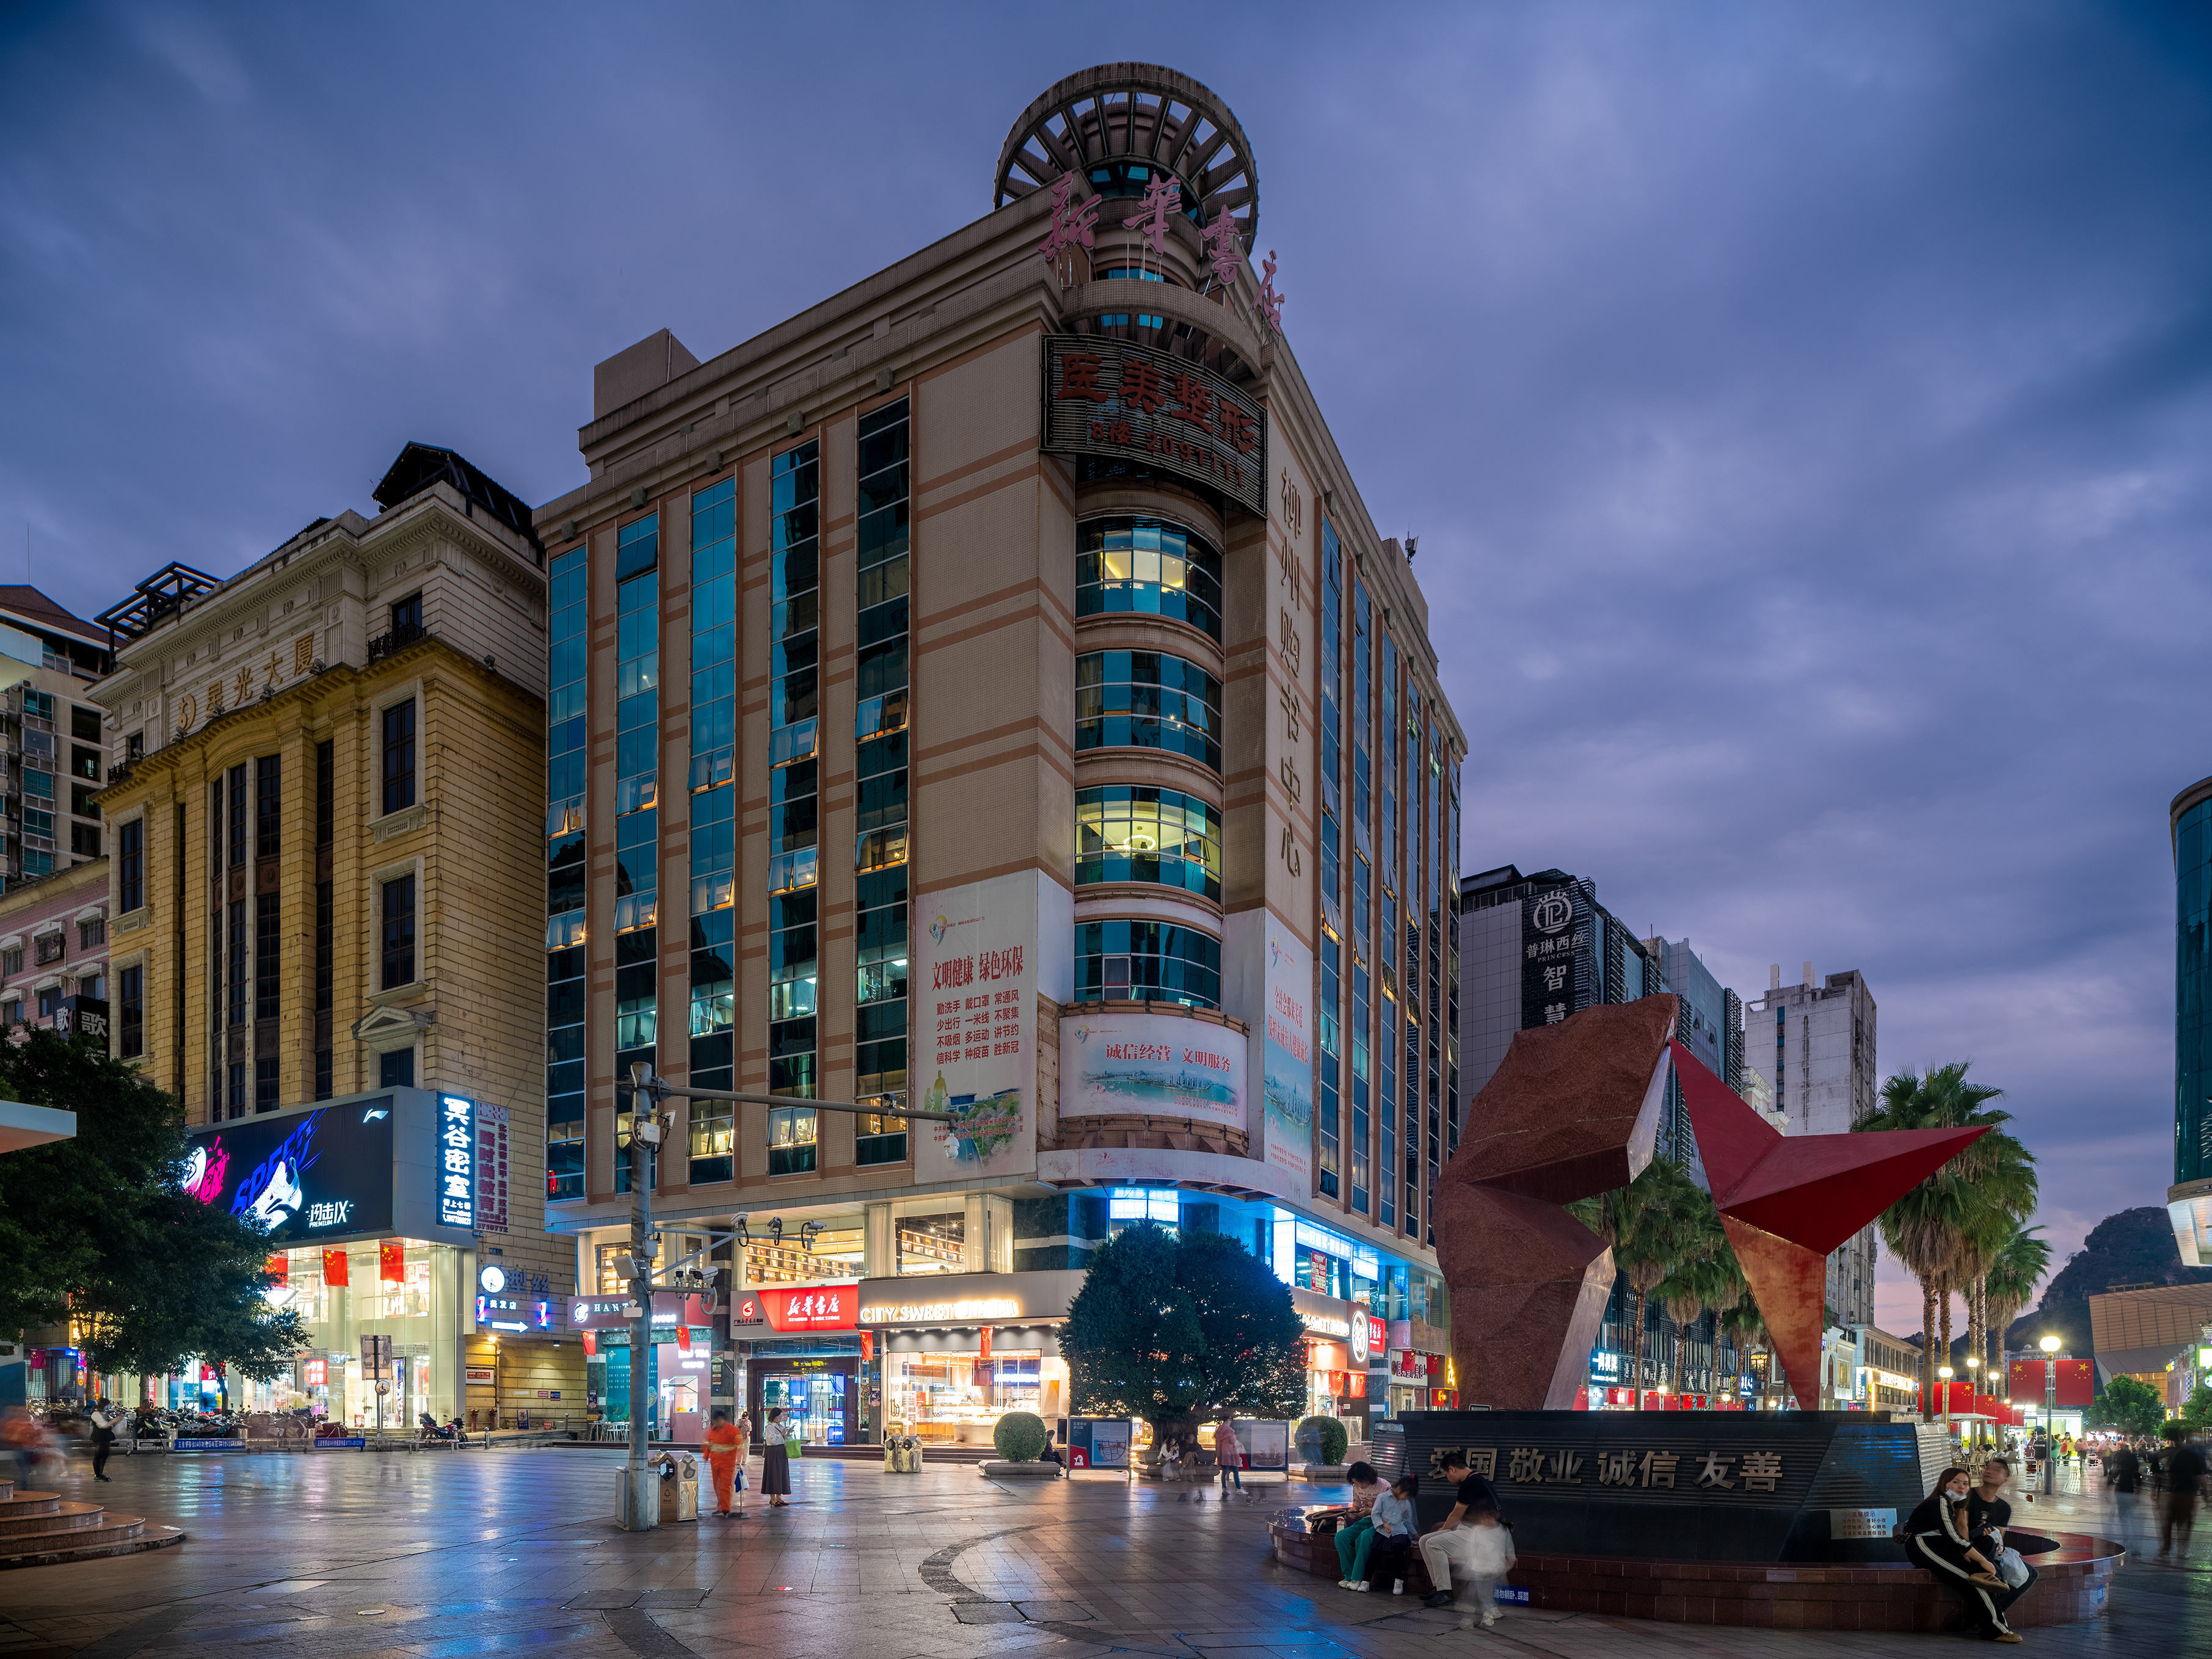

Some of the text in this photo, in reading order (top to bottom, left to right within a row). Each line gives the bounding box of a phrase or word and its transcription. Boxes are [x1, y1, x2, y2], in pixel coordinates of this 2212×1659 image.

[1057, 354, 1256, 453] 医美整形
[1091, 419, 1243, 488] 8楼 2091111
[205, 631, 315, 719] 星光大厦
[1281, 466, 1301, 878] 柳州购书中心
[1526, 932, 1585, 959] 普琳西丝
[1538, 950, 1575, 963] PRINCESS
[931, 945, 1024, 992] 文明健康 绿色环保
[937, 989, 1019, 1015] 勤洗手 戴口罩 常通风
[1275, 984, 1303, 1029] 全社会都来关爱
[57, 1006, 68, 1031] 歌
[81, 1011, 107, 1037] 歌
[937, 1006, 1019, 1032] 少出行 一米线 不聚集
[937, 1023, 1019, 1048] 不吸烟 多运动 讲节约
[1268, 1014, 1308, 1065] 保护未成年人健康成长
[937, 1040, 1019, 1065] 信科学 种疫苗 胜新冠
[1105, 1044, 1231, 1073] 诚信经营 文明服务
[498, 1124, 507, 1141] 化妆
[934, 1122, 972, 1133] 中共柳委宣传部
[976, 1116, 1016, 1127] 中共柳州市委文明办
[934, 1131, 972, 1142] 中共城委宣传部
[976, 1126, 1016, 1137] 中共城中区委文明办
[443, 1097, 471, 1199] 冥谷密室
[499, 1143, 507, 1160] 美容
[479, 1119, 496, 1211] 一路时尚教育
[499, 1161, 507, 1178] 美甲
[309, 1219, 333, 1228] PREMIUM
[477, 1222, 508, 1233] 3710772
[508, 1269, 550, 1293] 型丝
[490, 1299, 517, 1310] 美发店
[1509, 1448, 1584, 1484] 敬业
[1597, 1450, 1681, 1489] 诚信
[1692, 1451, 1783, 1492] 友善
[1494, 1589, 1529, 1601] 请勿躺卧、踩踏
